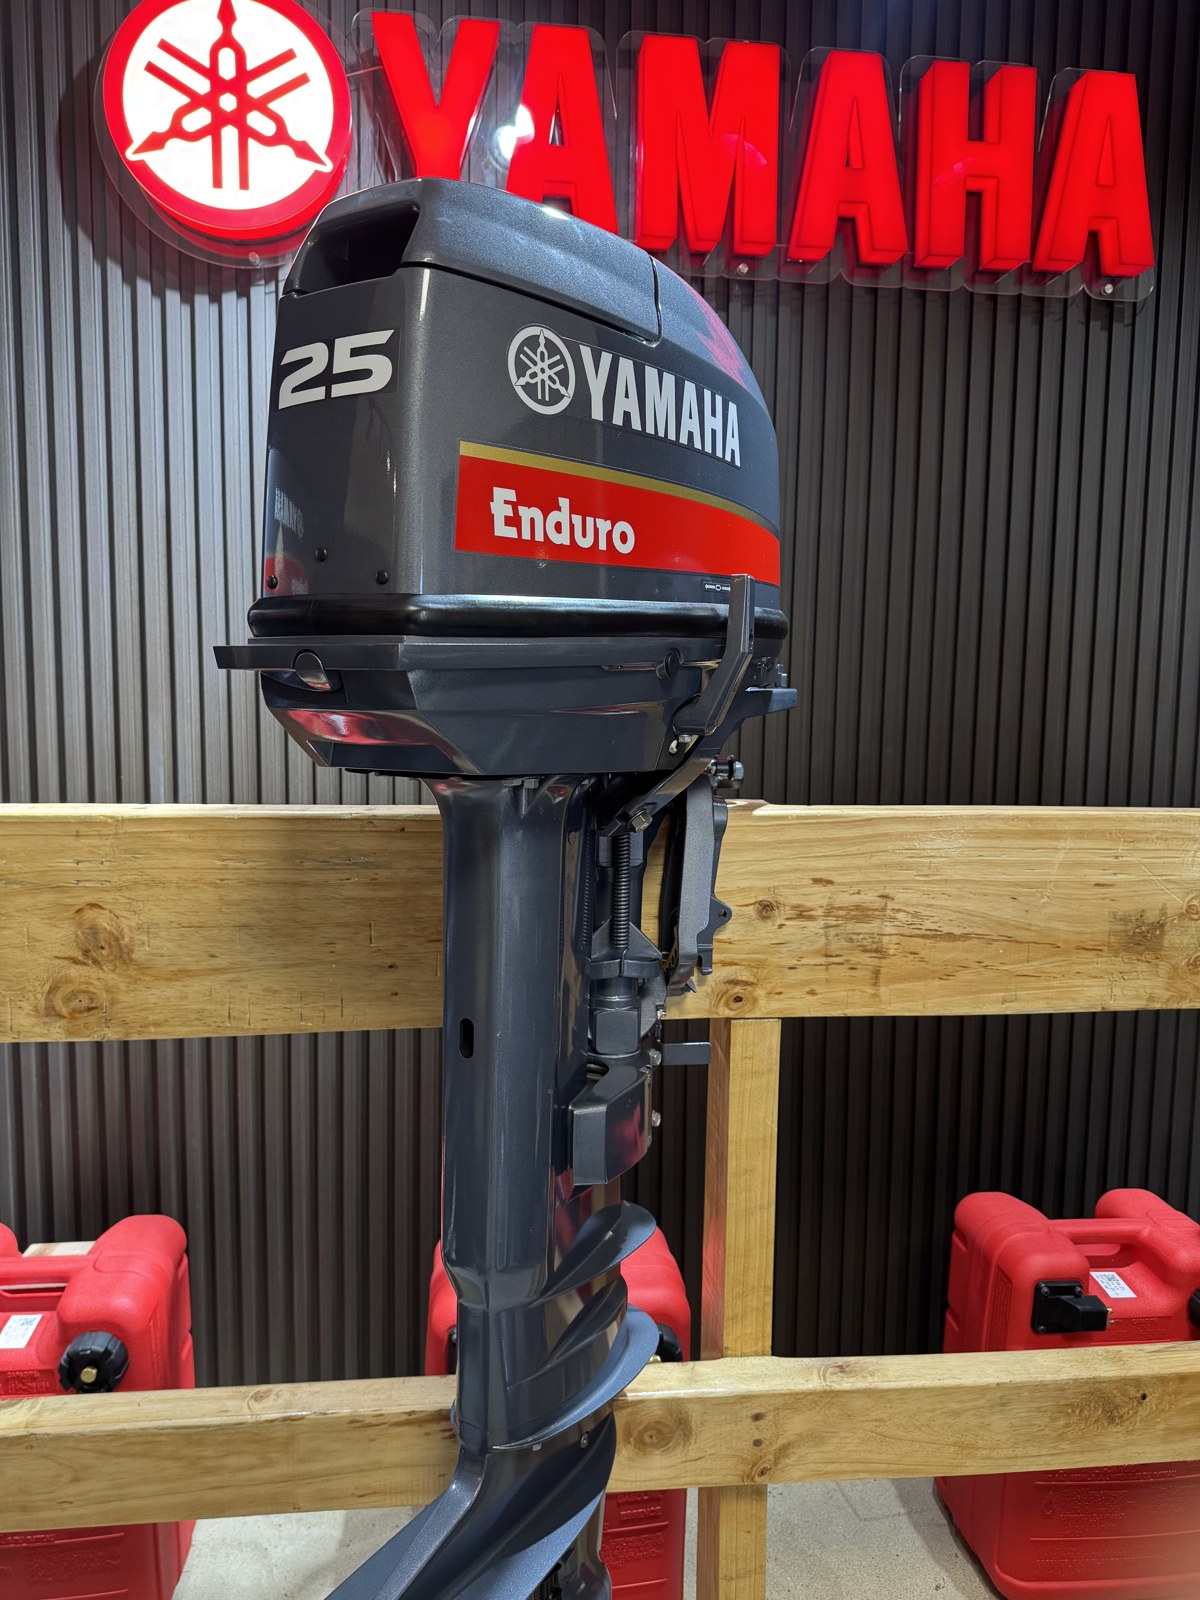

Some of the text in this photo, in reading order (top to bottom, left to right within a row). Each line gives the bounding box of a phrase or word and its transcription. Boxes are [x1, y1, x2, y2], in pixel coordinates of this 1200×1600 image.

[371, 11, 1155, 278] YAMAHA
[278, 329, 395, 410] 25
[579, 344, 741, 467] YAMAHA
[490, 486, 636, 554] Enduro
